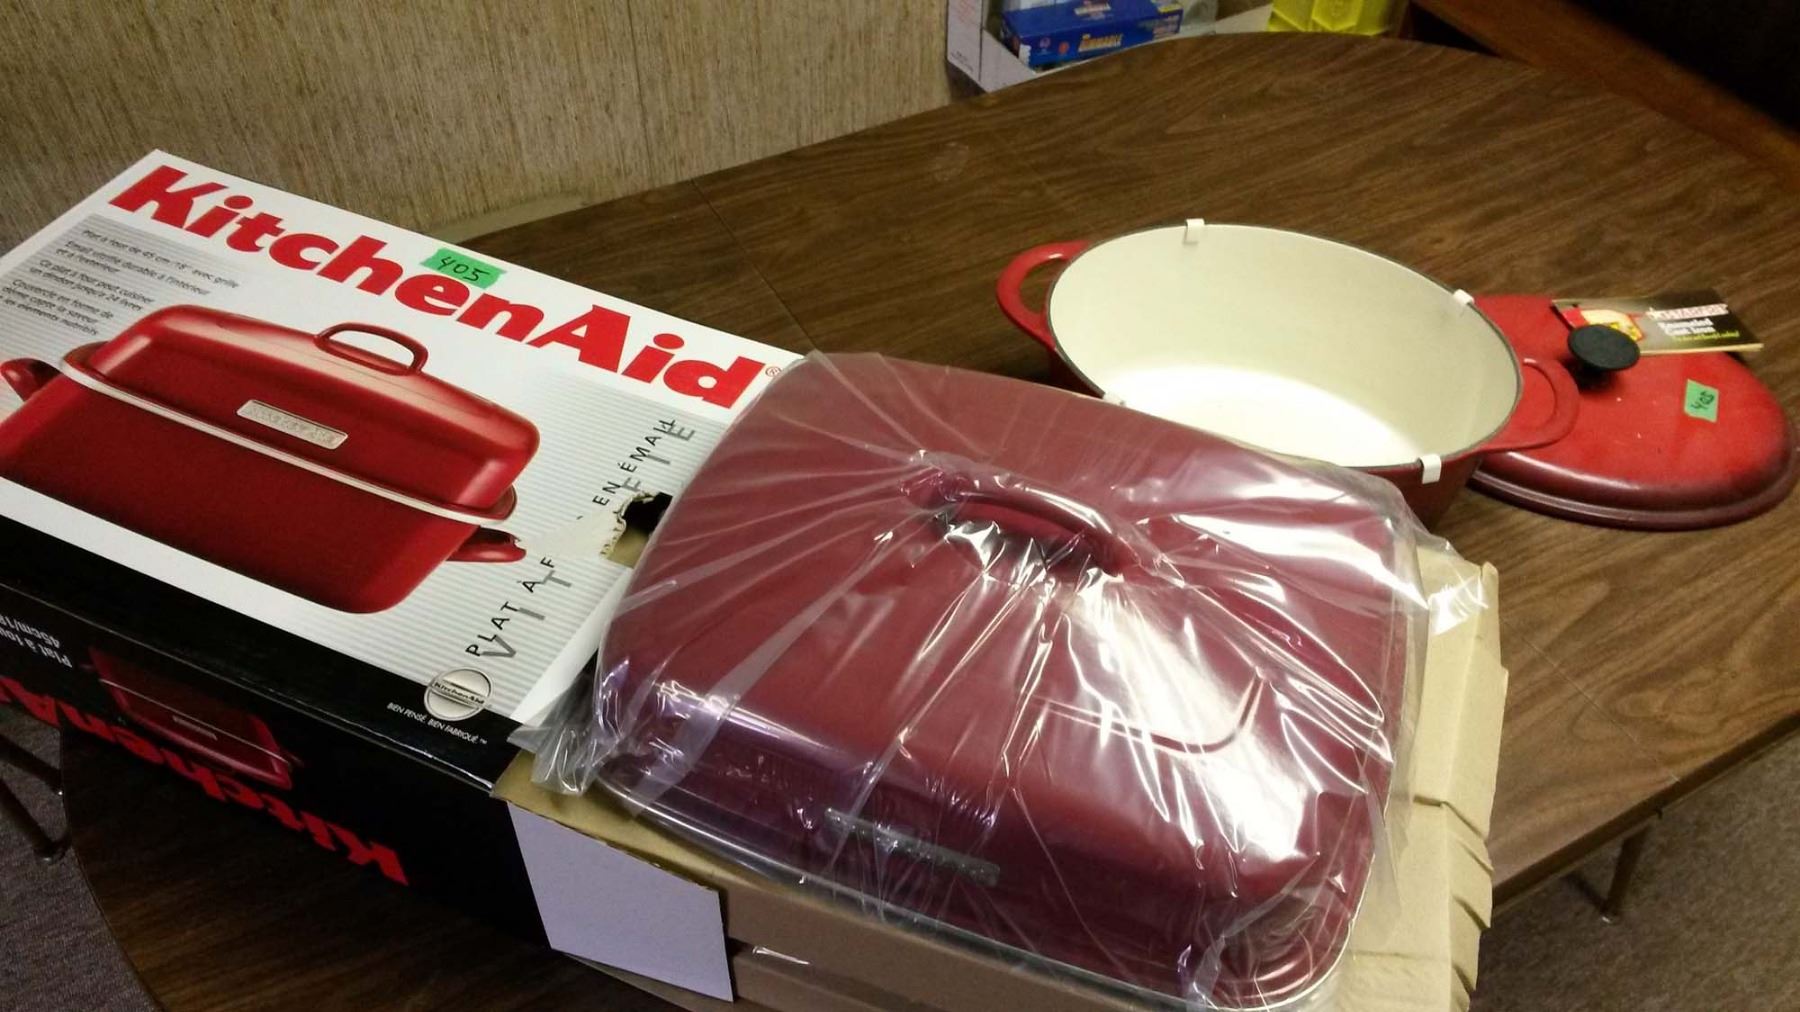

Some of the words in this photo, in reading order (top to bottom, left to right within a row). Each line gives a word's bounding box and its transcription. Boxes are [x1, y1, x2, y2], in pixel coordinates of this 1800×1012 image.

[437, 256, 491, 282] 405
[108, 165, 767, 409] KitchenAid
[592, 480, 622, 506] EN
[0, 626, 25, 646] fou
[465, 601, 518, 657] PLAT
[37, 643, 73, 668] Plat
[433, 681, 485, 705] KitchenAid
[386, 701, 405, 715] BIEN
[427, 718, 446, 731] BIEN
[0, 674, 409, 887] KitchenA
